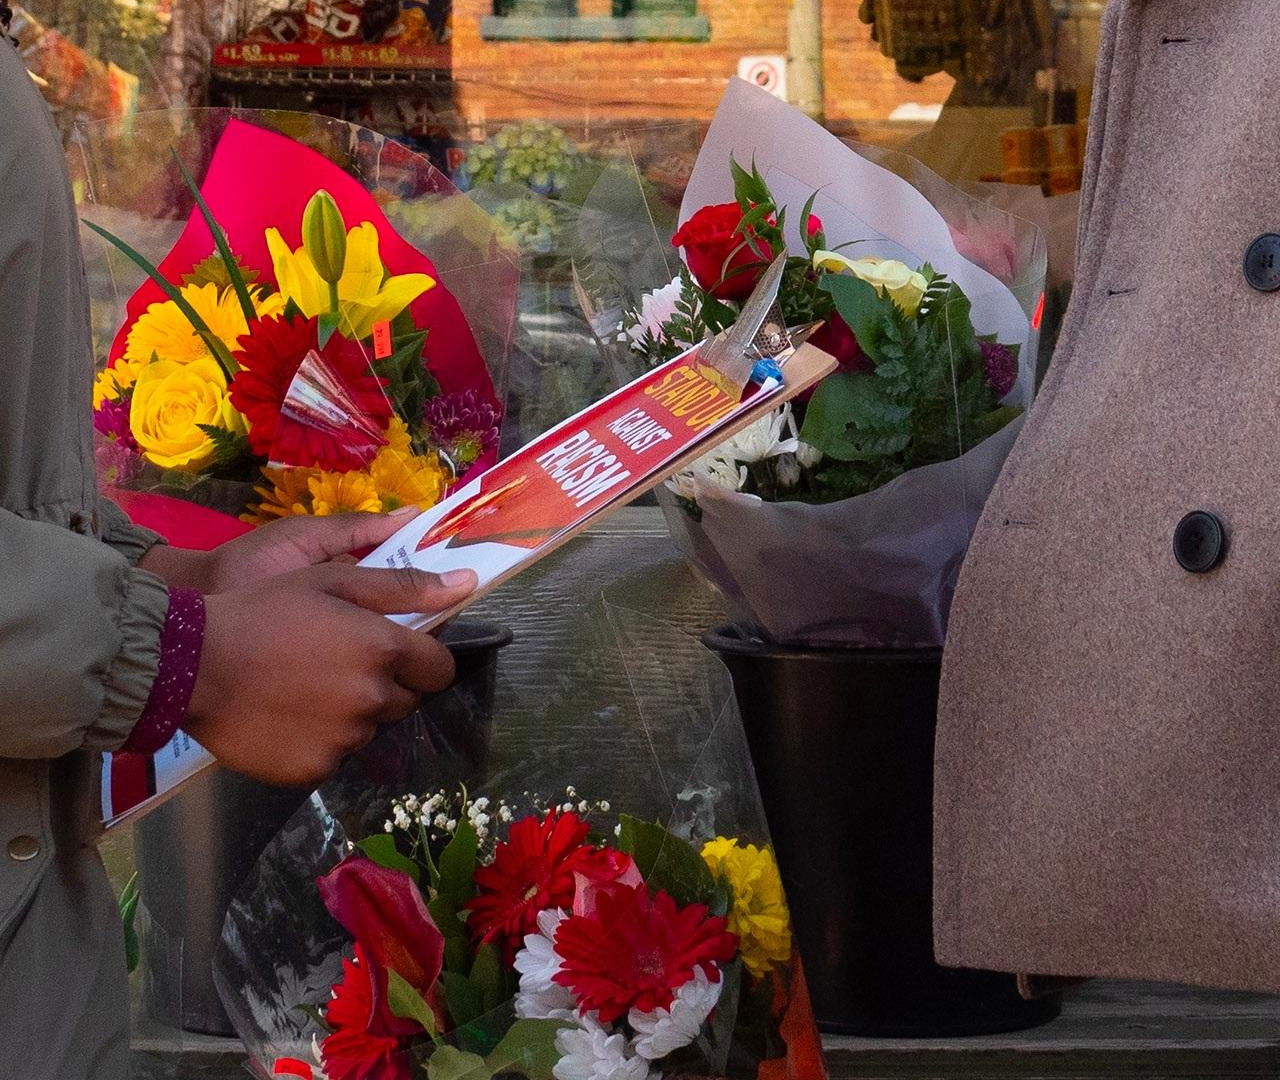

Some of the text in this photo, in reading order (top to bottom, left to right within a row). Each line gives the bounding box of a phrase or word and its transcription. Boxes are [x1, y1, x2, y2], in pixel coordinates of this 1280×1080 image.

[606, 407, 673, 455] AGAINST
[644, 365, 742, 432] STAND UP
[535, 429, 631, 508] RACISM
